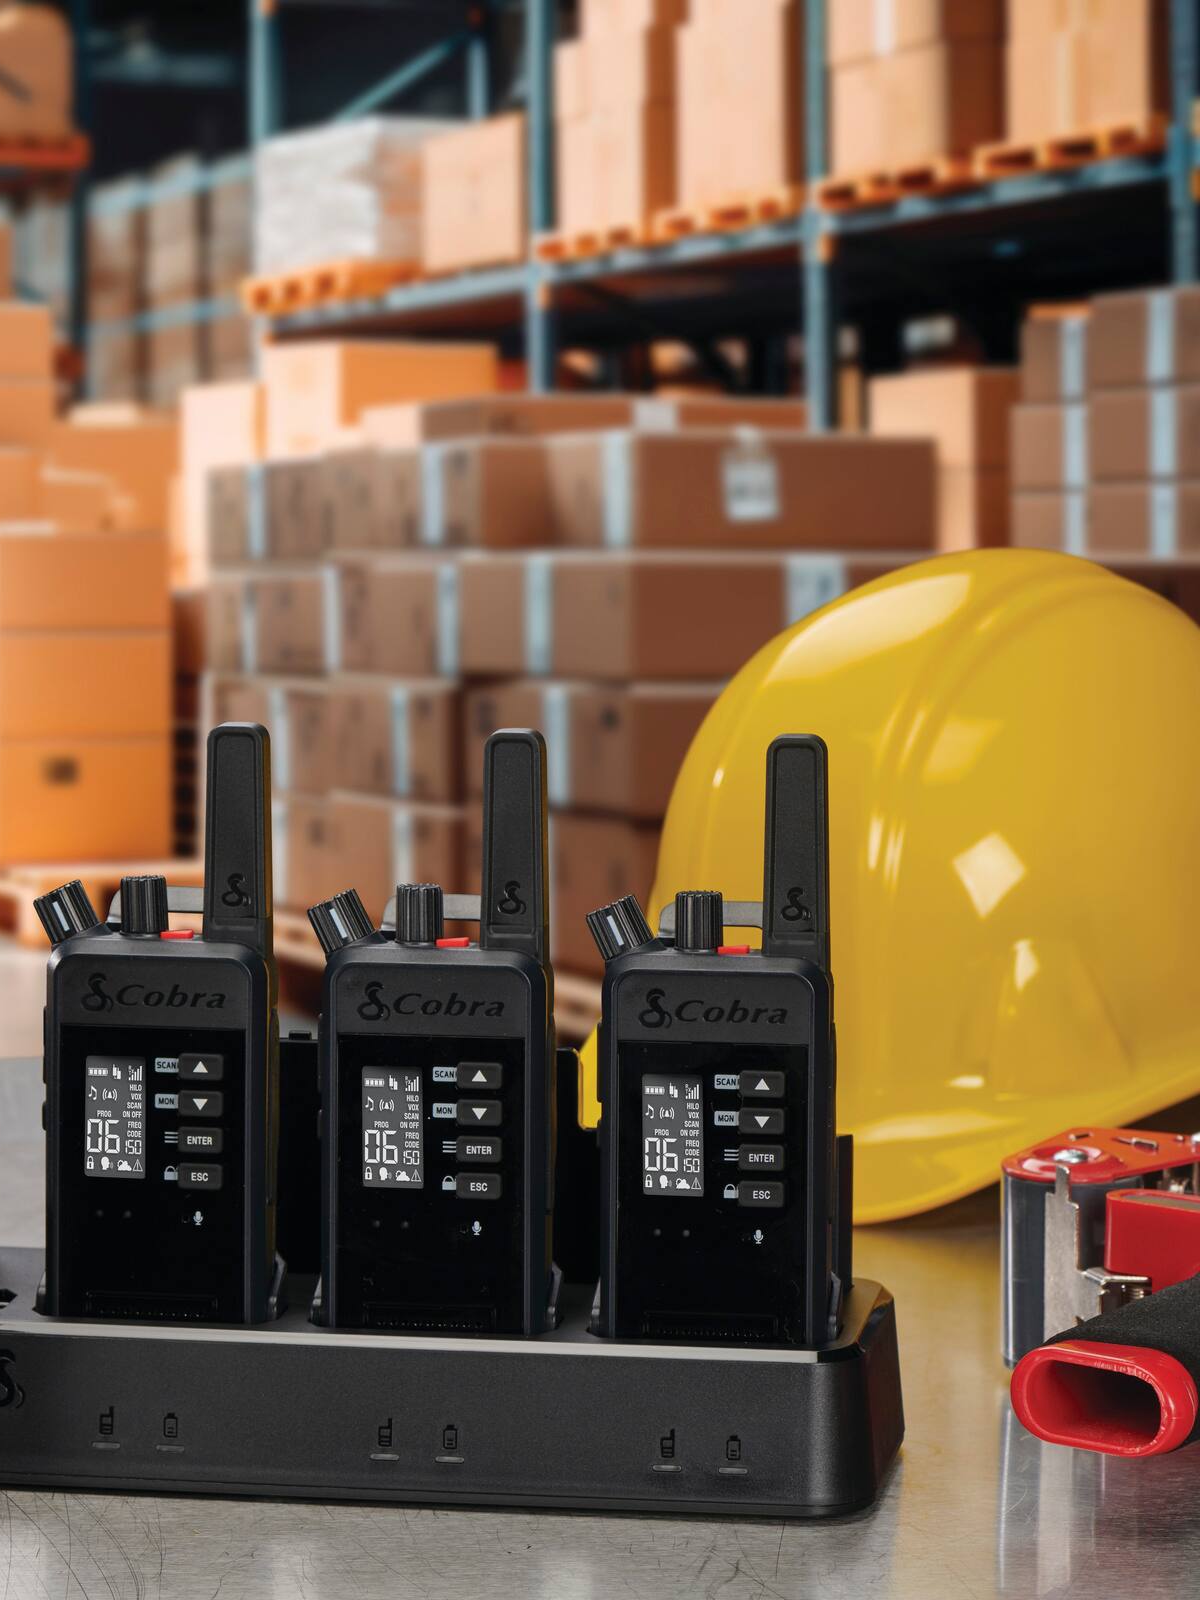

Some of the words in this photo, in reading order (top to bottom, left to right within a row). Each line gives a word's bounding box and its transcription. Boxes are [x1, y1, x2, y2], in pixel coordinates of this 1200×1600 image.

[116, 984, 226, 1008] Cobra
[393, 992, 505, 1017] Cobra
[674, 999, 788, 1025] Cobra
[87, 1119, 120, 1154] 06
[187, 1136, 212, 1145] ENTER
[365, 1130, 398, 1164] 06
[466, 1146, 492, 1155] ENTER
[645, 1137, 678, 1172] 06
[749, 1154, 774, 1163] ENTER
[191, 1172, 208, 1181] ESC
[470, 1182, 488, 1191] ESC
[753, 1190, 770, 1199] ESC
